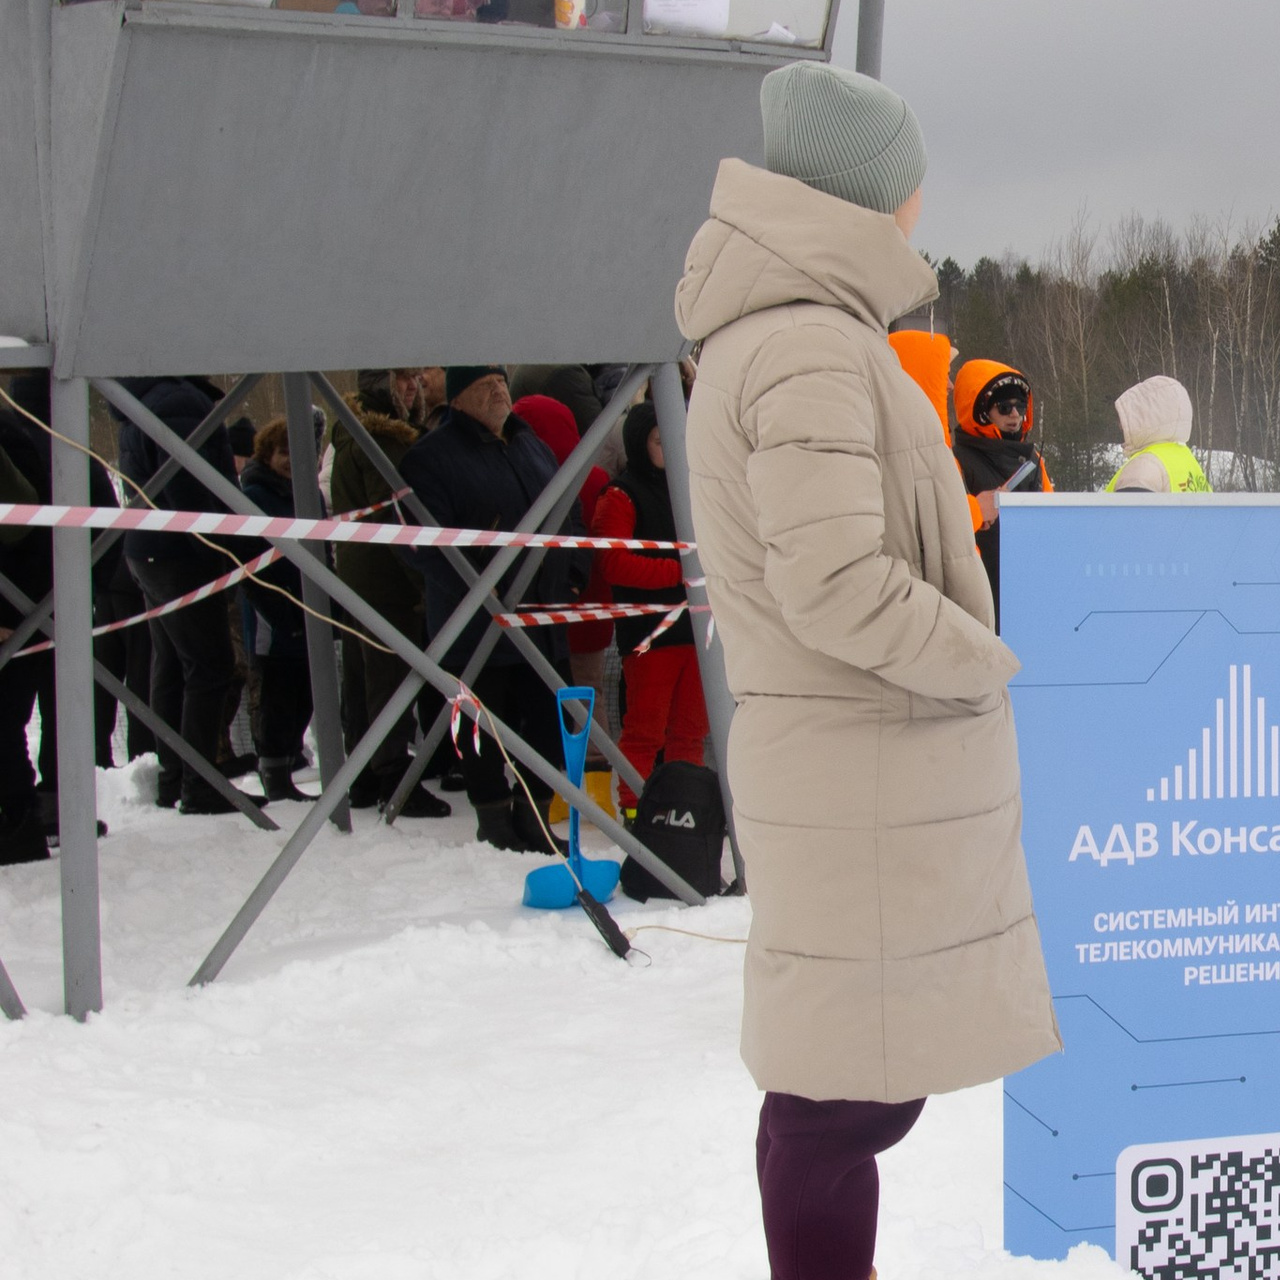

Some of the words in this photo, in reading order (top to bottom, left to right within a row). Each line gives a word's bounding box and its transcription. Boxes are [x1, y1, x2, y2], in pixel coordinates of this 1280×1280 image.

[651, 808, 696, 829] FILA
[1068, 822, 1159, 867] АДВ
[1093, 900, 1239, 933] СИСТЕМНЫЙ
